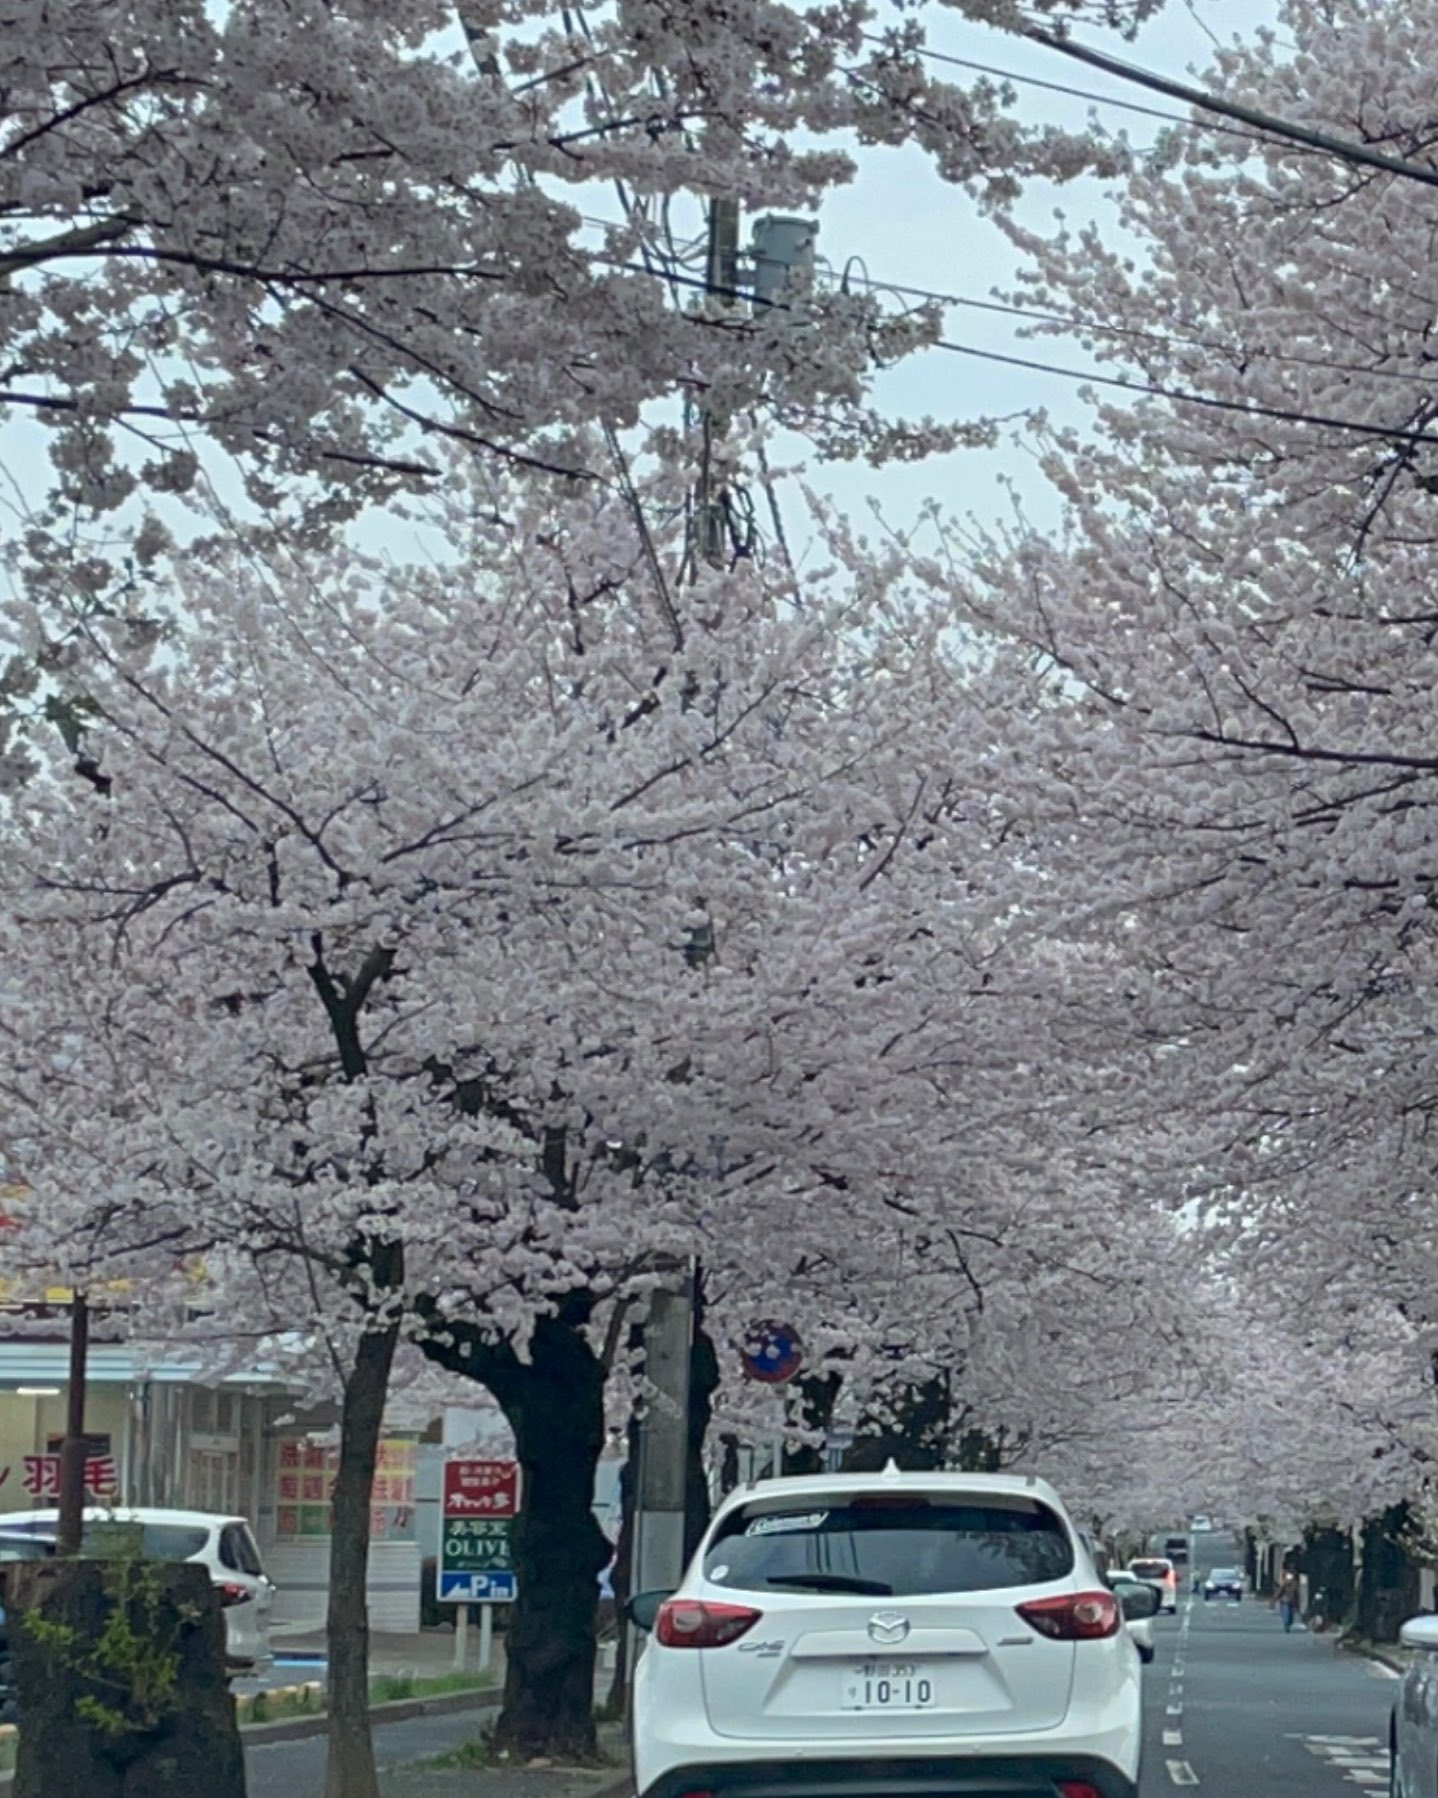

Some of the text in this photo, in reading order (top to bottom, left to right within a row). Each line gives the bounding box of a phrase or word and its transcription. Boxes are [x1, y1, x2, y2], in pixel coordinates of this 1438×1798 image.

[449, 1520, 508, 1535] 美容室
[866, 1680, 931, 1703] 10-10
